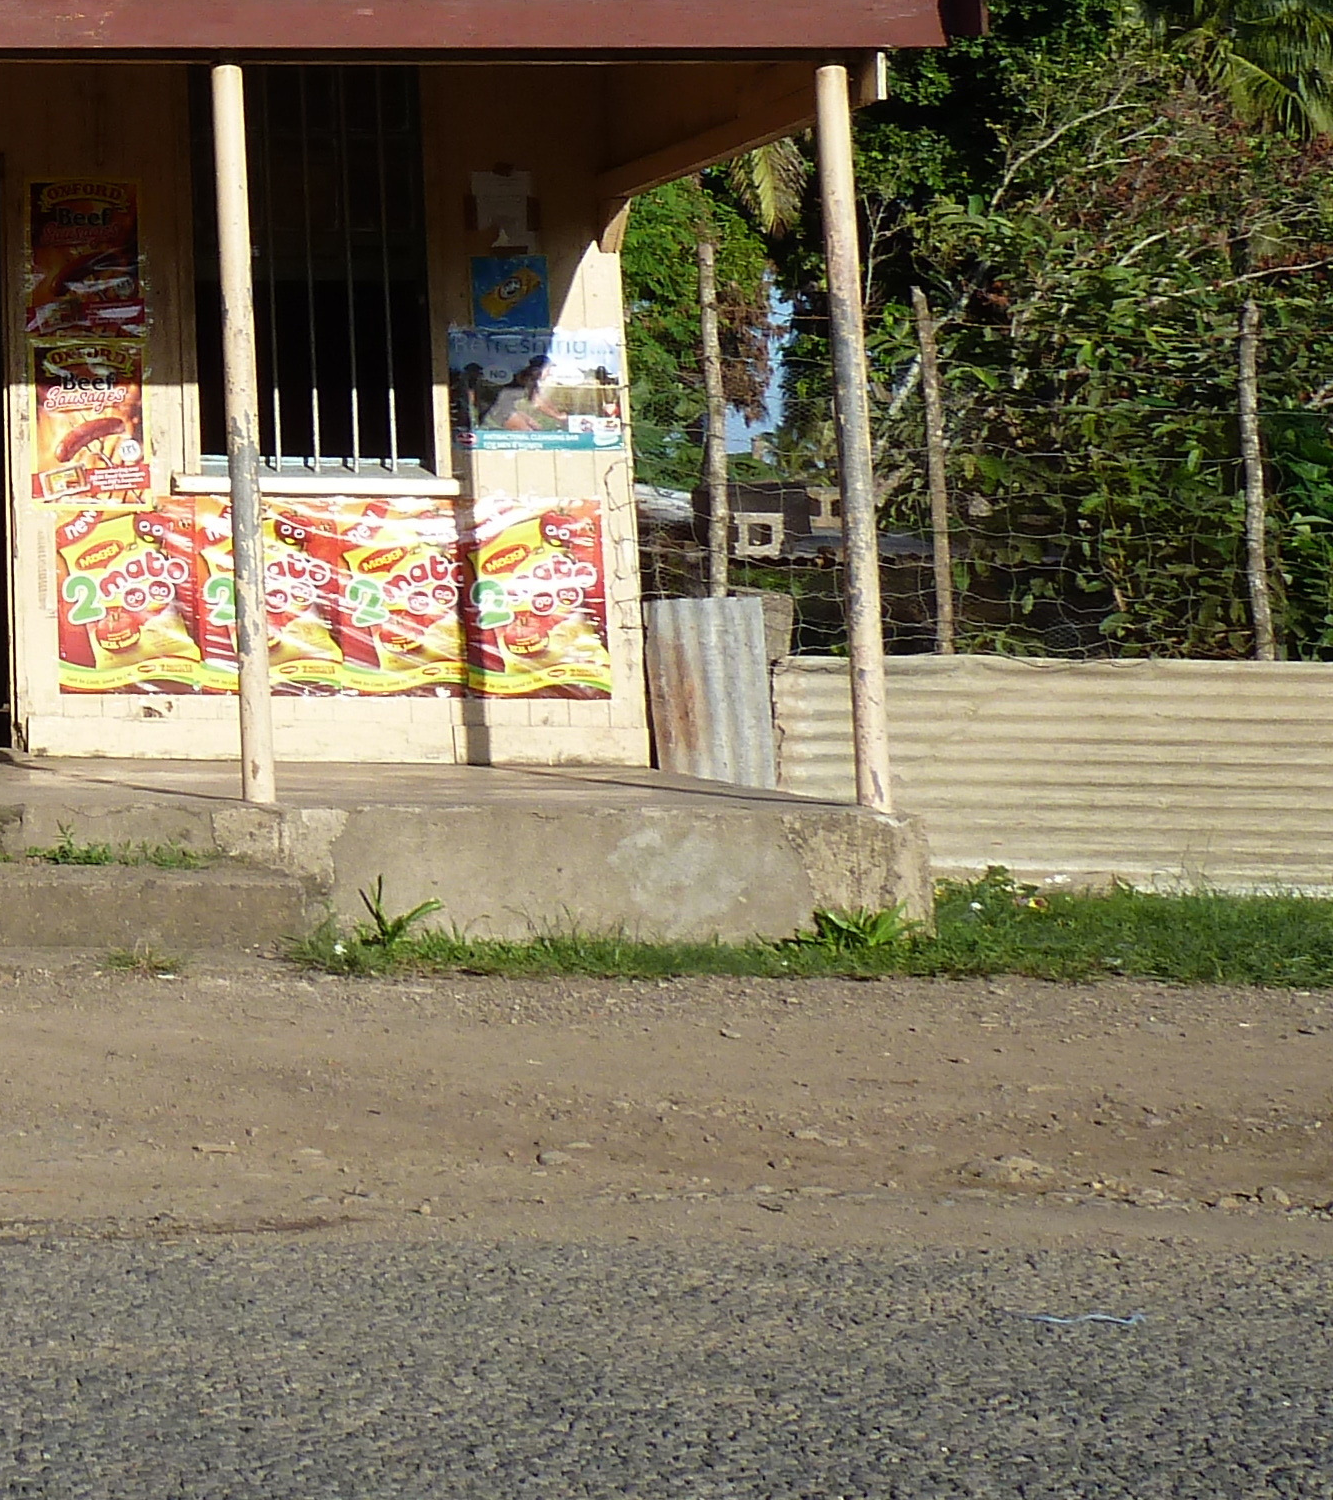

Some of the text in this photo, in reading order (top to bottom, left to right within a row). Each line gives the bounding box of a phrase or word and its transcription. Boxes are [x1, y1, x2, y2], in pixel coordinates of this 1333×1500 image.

[47, 182, 123, 200] OXFORD
[56, 208, 113, 226] Beef
[43, 222, 120, 247] Sausages
[51, 349, 127, 365] OXFORD
[62, 373, 116, 391] Beef
[489, 370, 507, 379] NO
[45, 386, 127, 412] Sausages
[64, 510, 98, 541] new
[79, 544, 119, 570] Maggi
[362, 548, 404, 571] Maggi
[486, 547, 526, 572] Maggi
